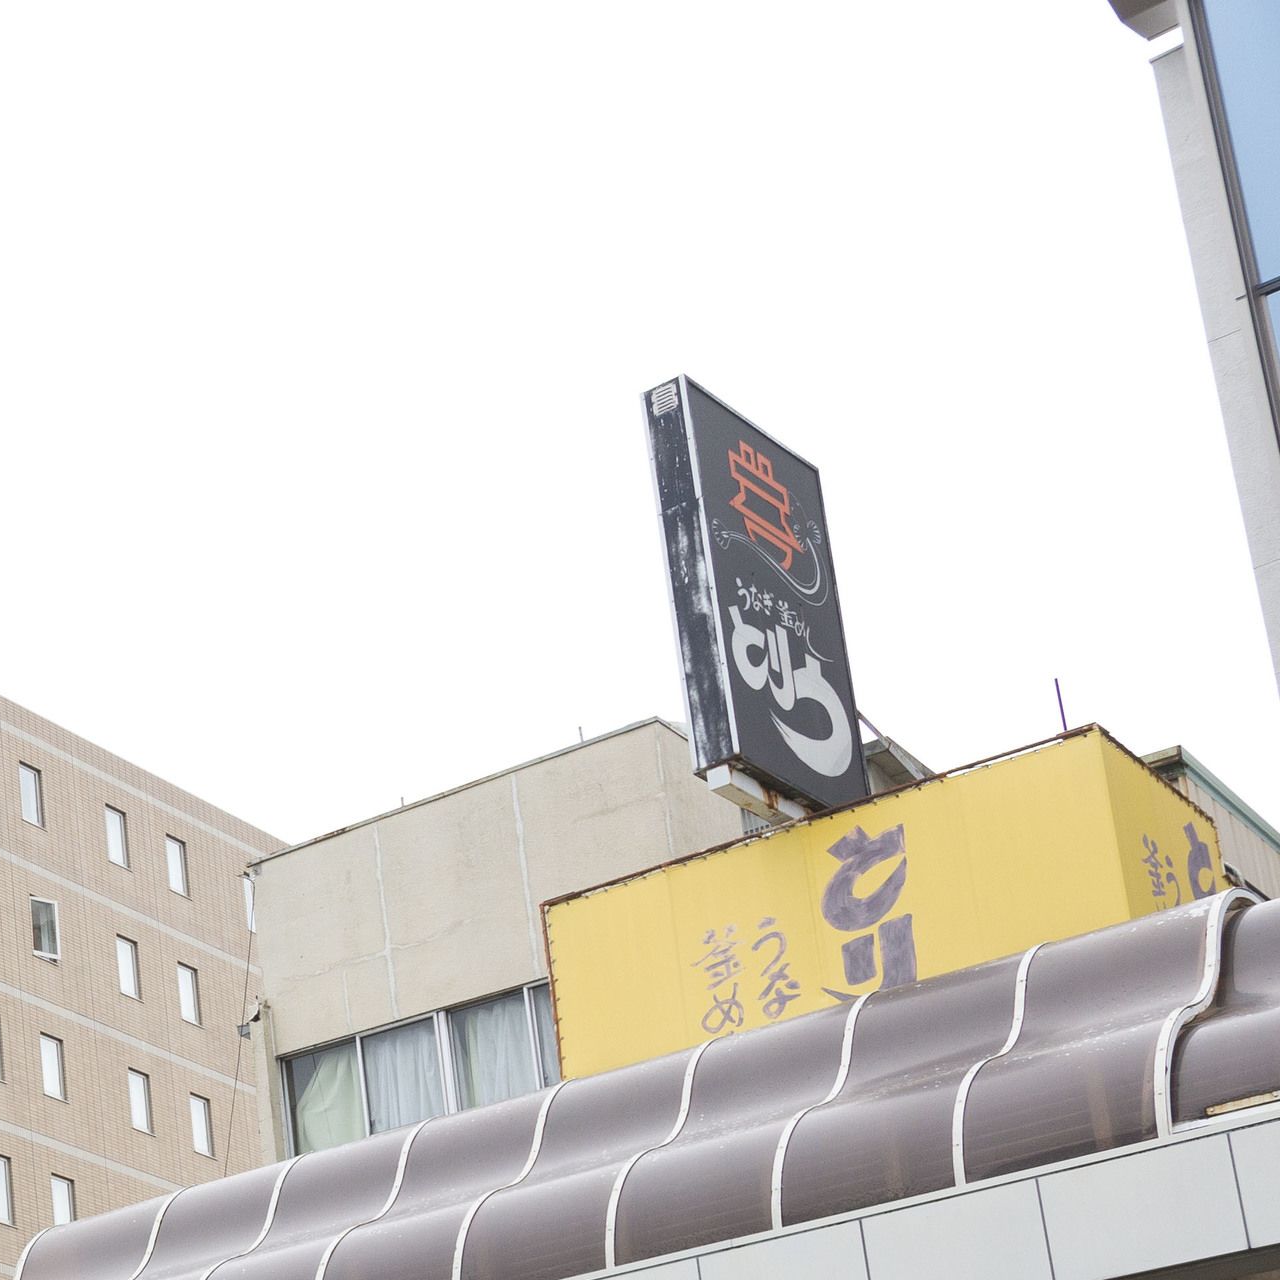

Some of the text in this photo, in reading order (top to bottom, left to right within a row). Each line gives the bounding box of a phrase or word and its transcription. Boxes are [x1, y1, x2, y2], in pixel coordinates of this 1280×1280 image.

[736, 577, 773, 615] うなぎ
[821, 823, 918, 1002] とり
[691, 925, 745, 1035] 釜め
